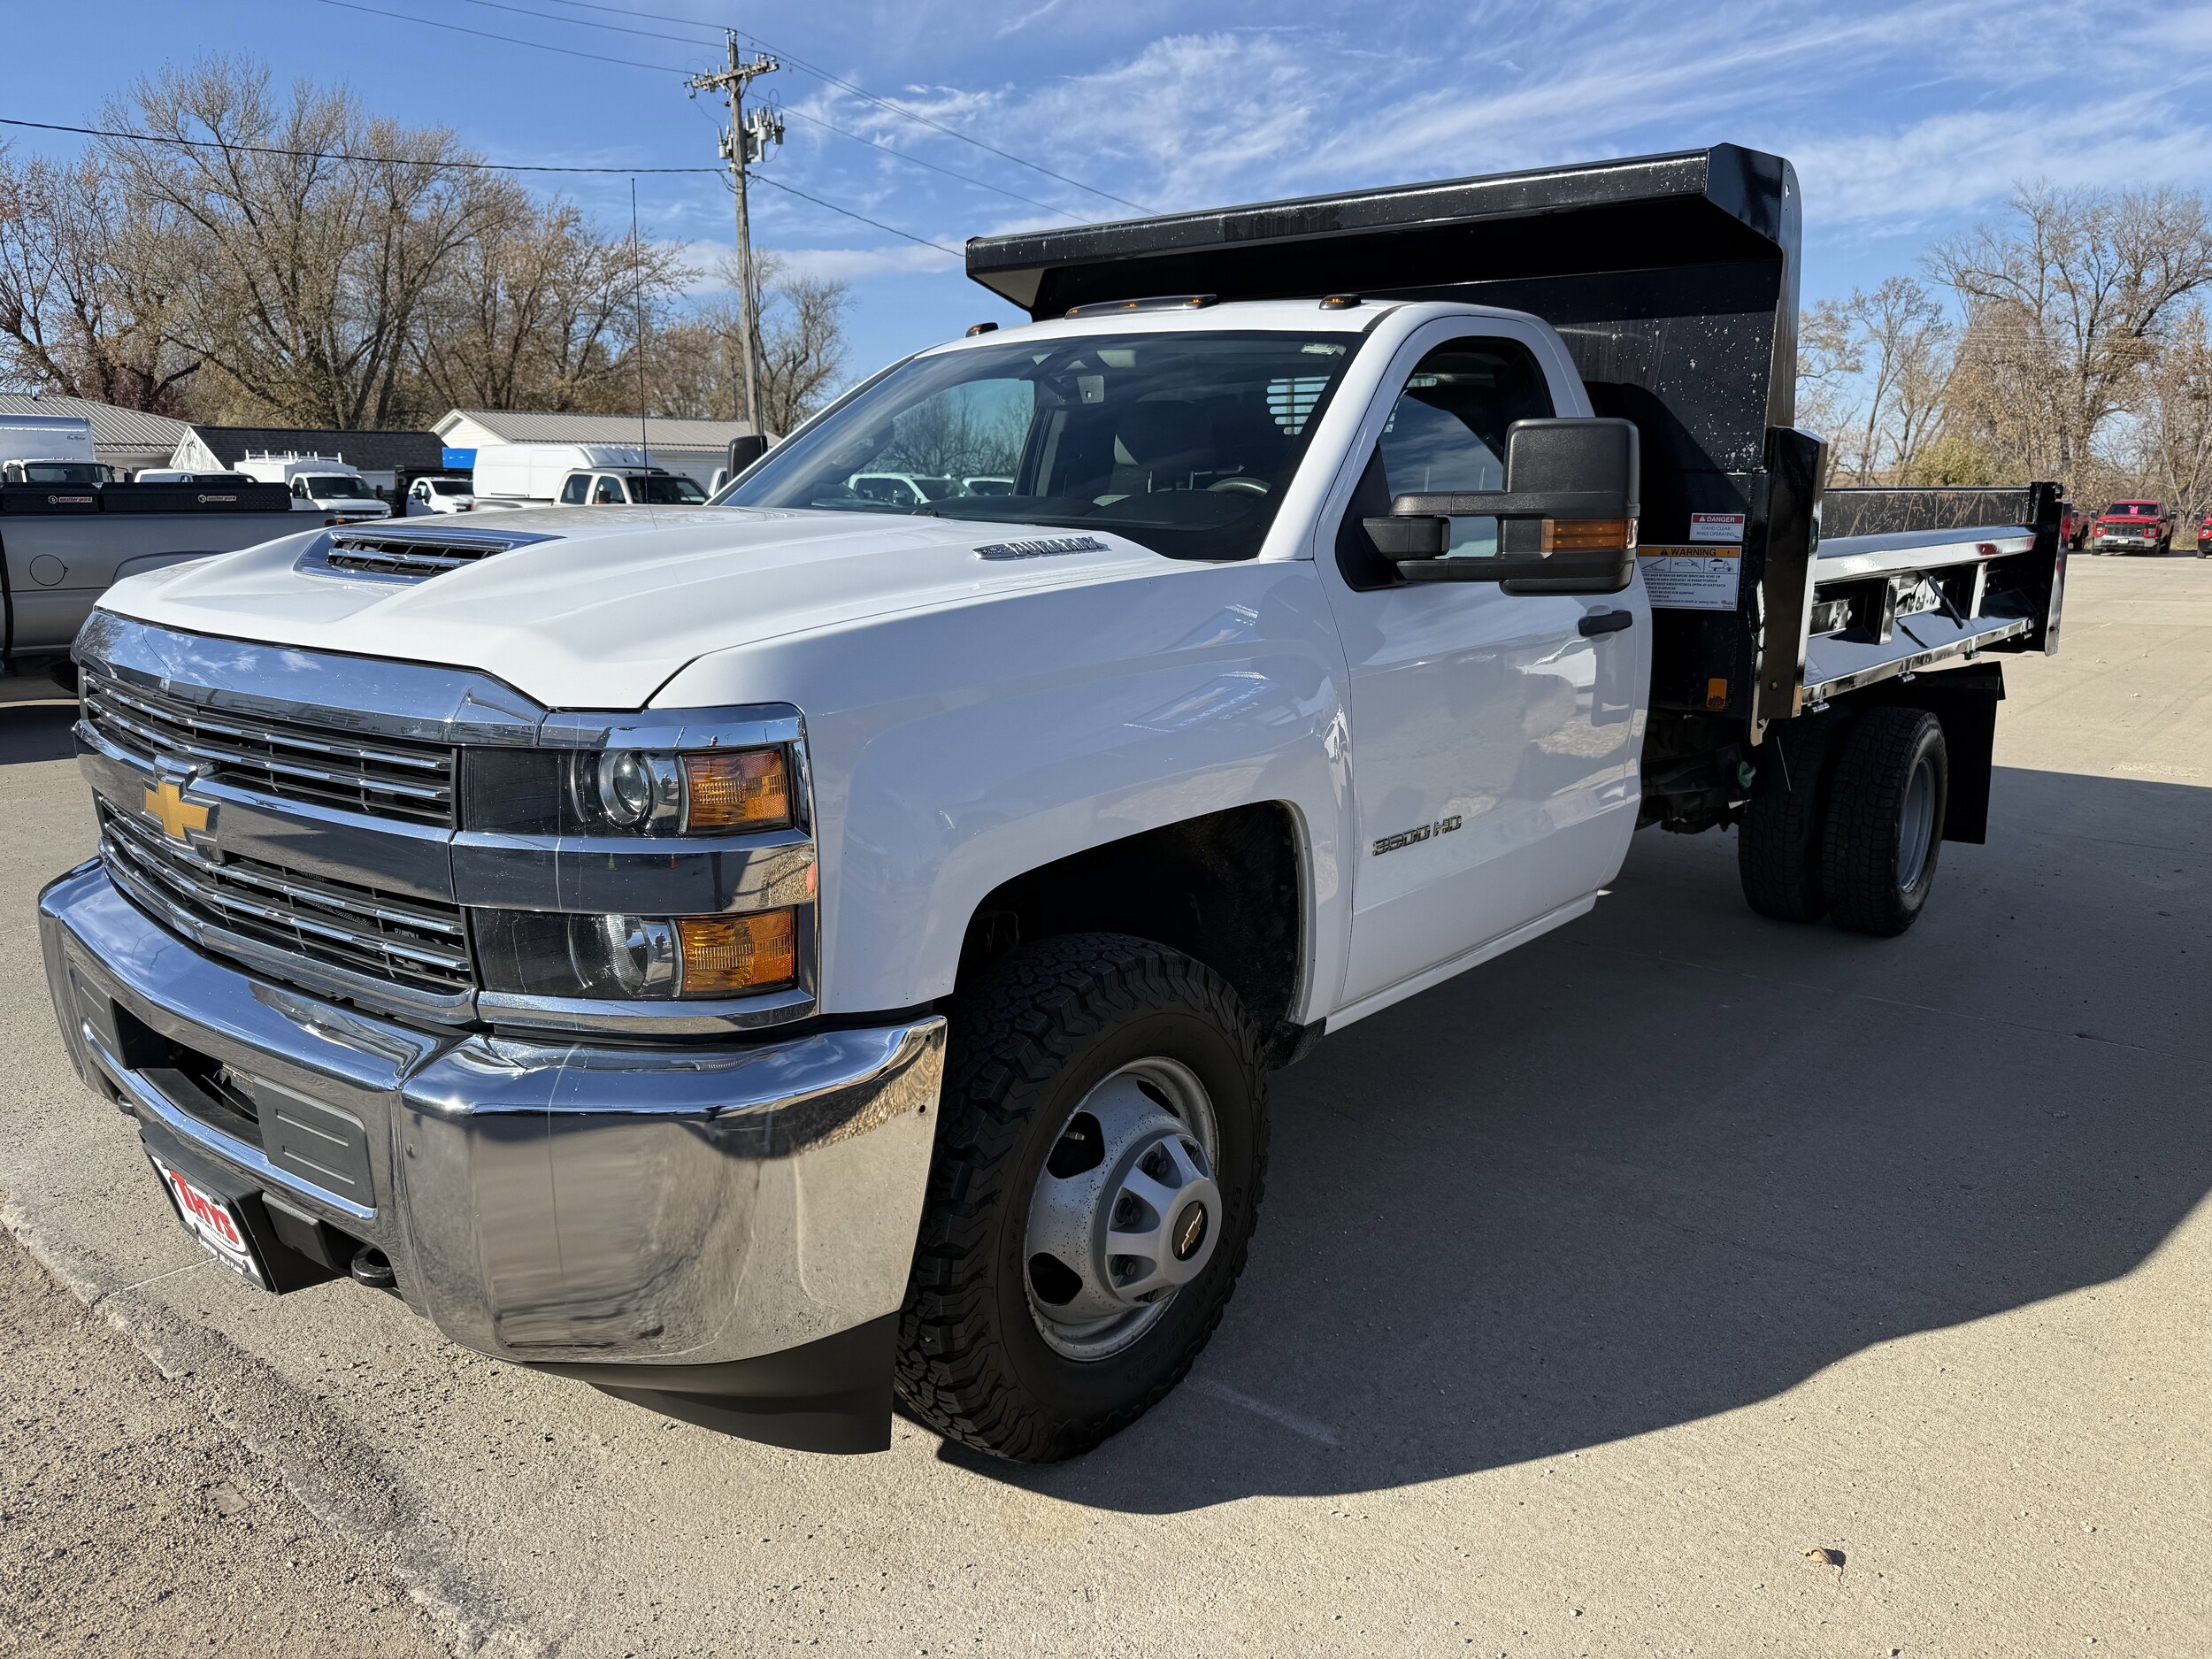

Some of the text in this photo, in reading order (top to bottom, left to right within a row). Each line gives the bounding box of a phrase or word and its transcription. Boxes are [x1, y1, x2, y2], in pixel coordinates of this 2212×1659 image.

[1005, 536, 1110, 557] DURAMAX
[1372, 814, 1463, 856] 3500 HD
[169, 1169, 239, 1245] THYS
